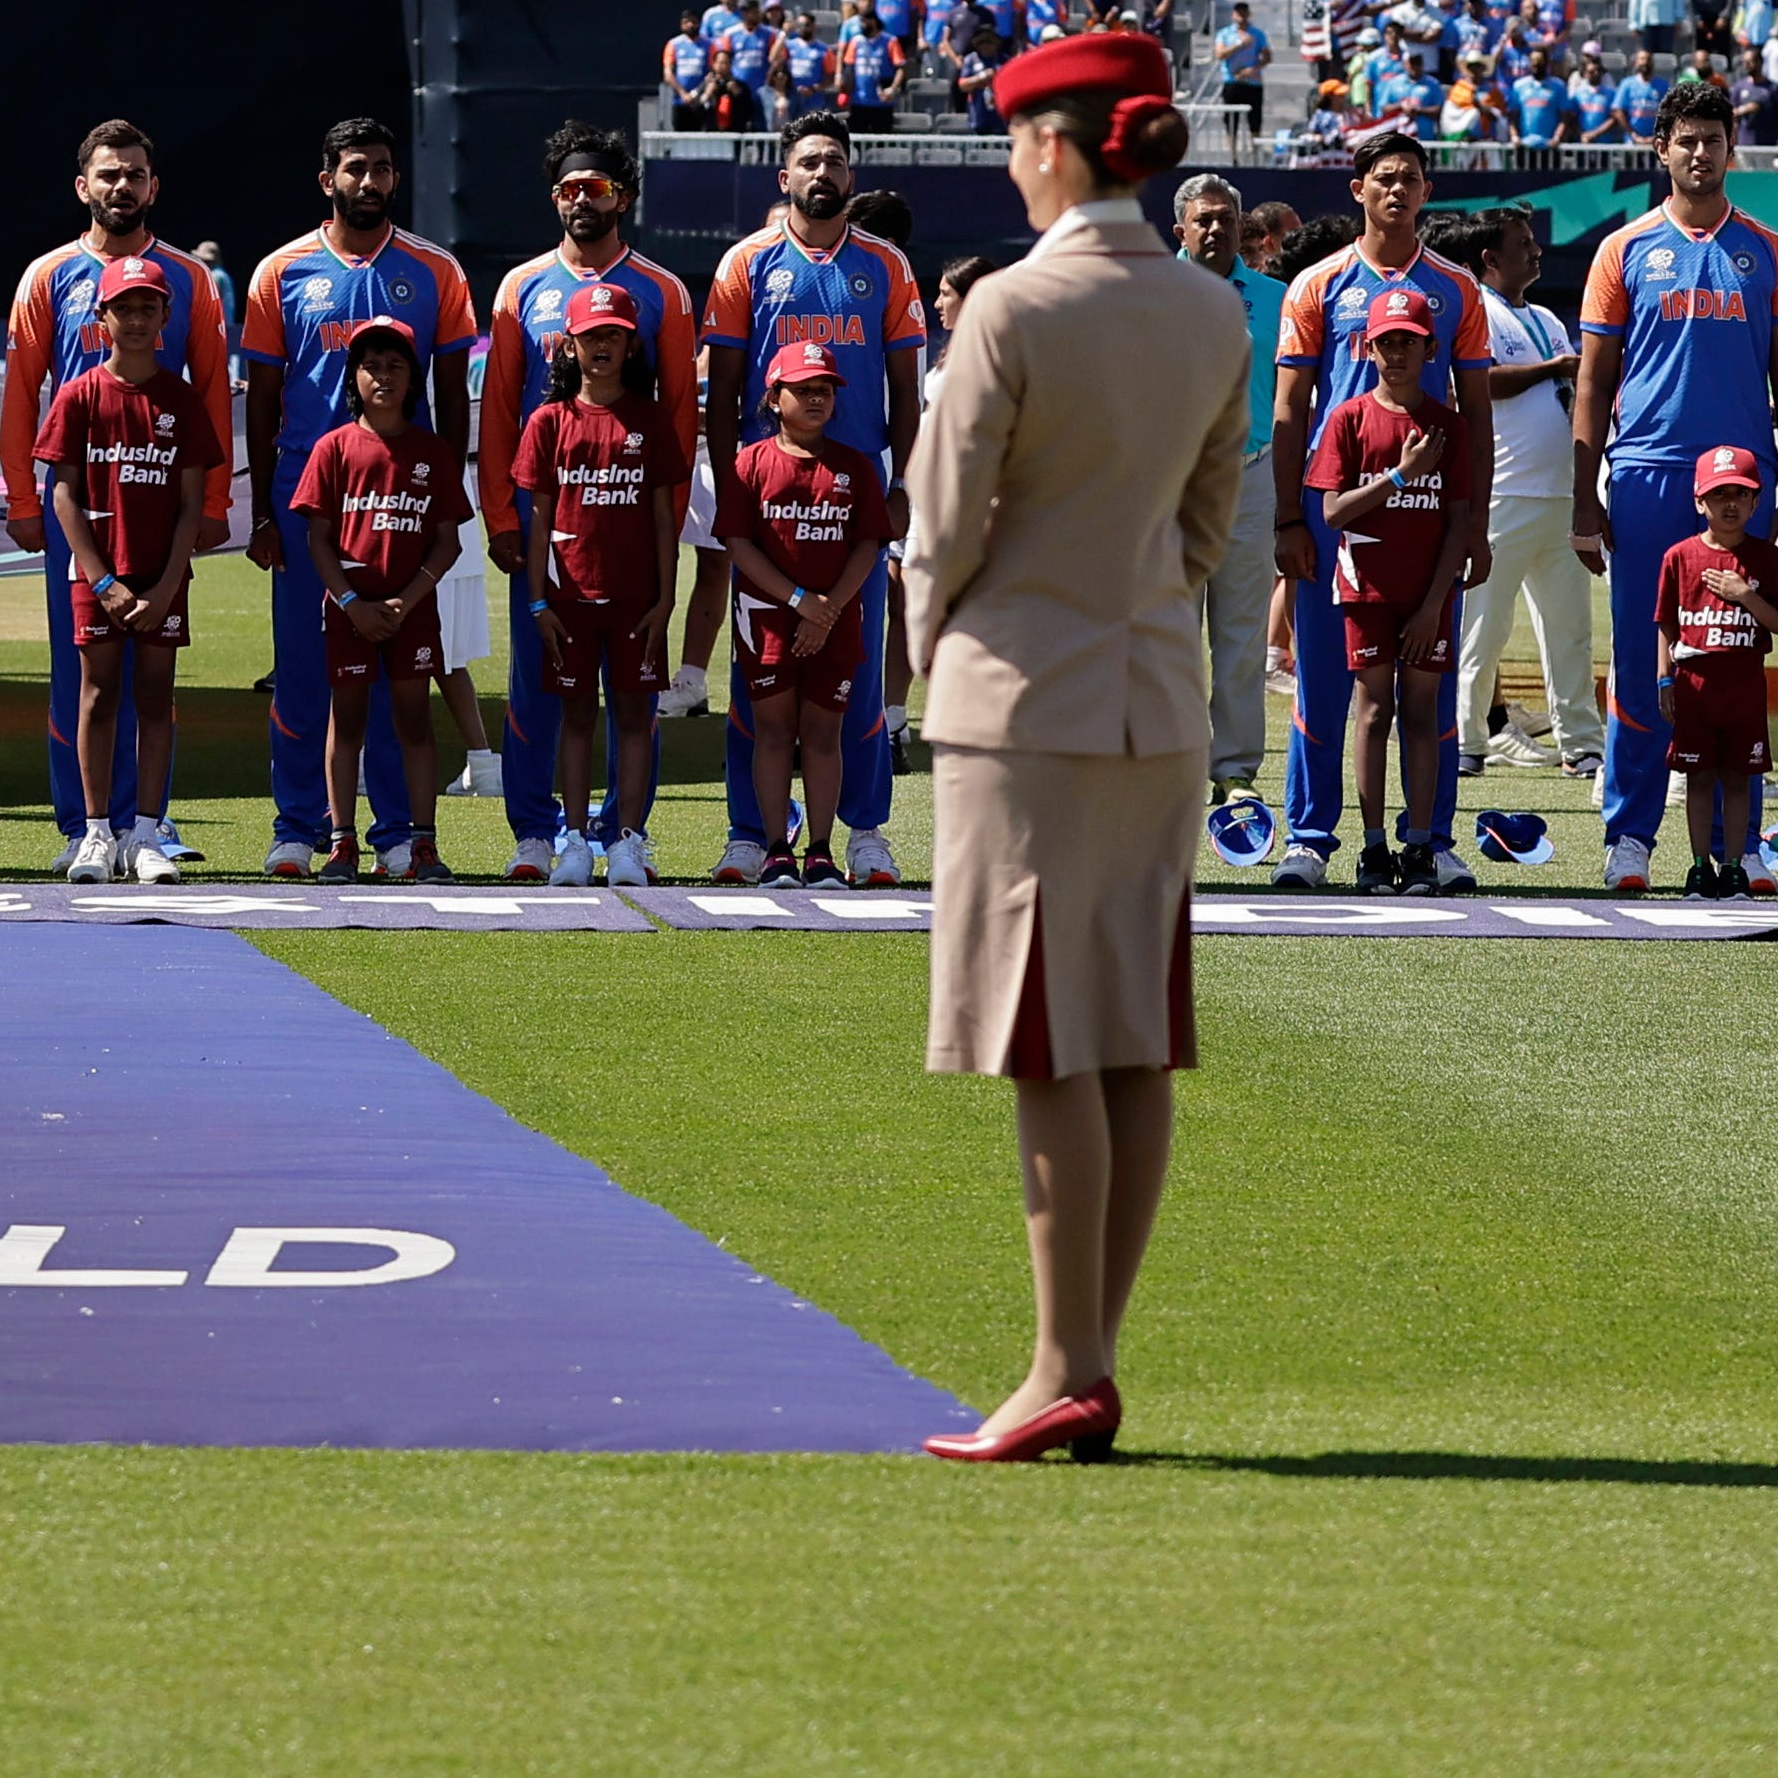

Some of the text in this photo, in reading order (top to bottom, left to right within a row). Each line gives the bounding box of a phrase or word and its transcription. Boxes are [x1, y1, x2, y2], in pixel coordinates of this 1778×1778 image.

[1660, 289, 1747, 322] INDIA
[776, 315, 865, 345] INDIA
[342, 490, 432, 515] IndusInd
[581, 485, 640, 506] Bank
[1385, 490, 1440, 510] Bank
[1678, 605, 1759, 628] IndusIn
